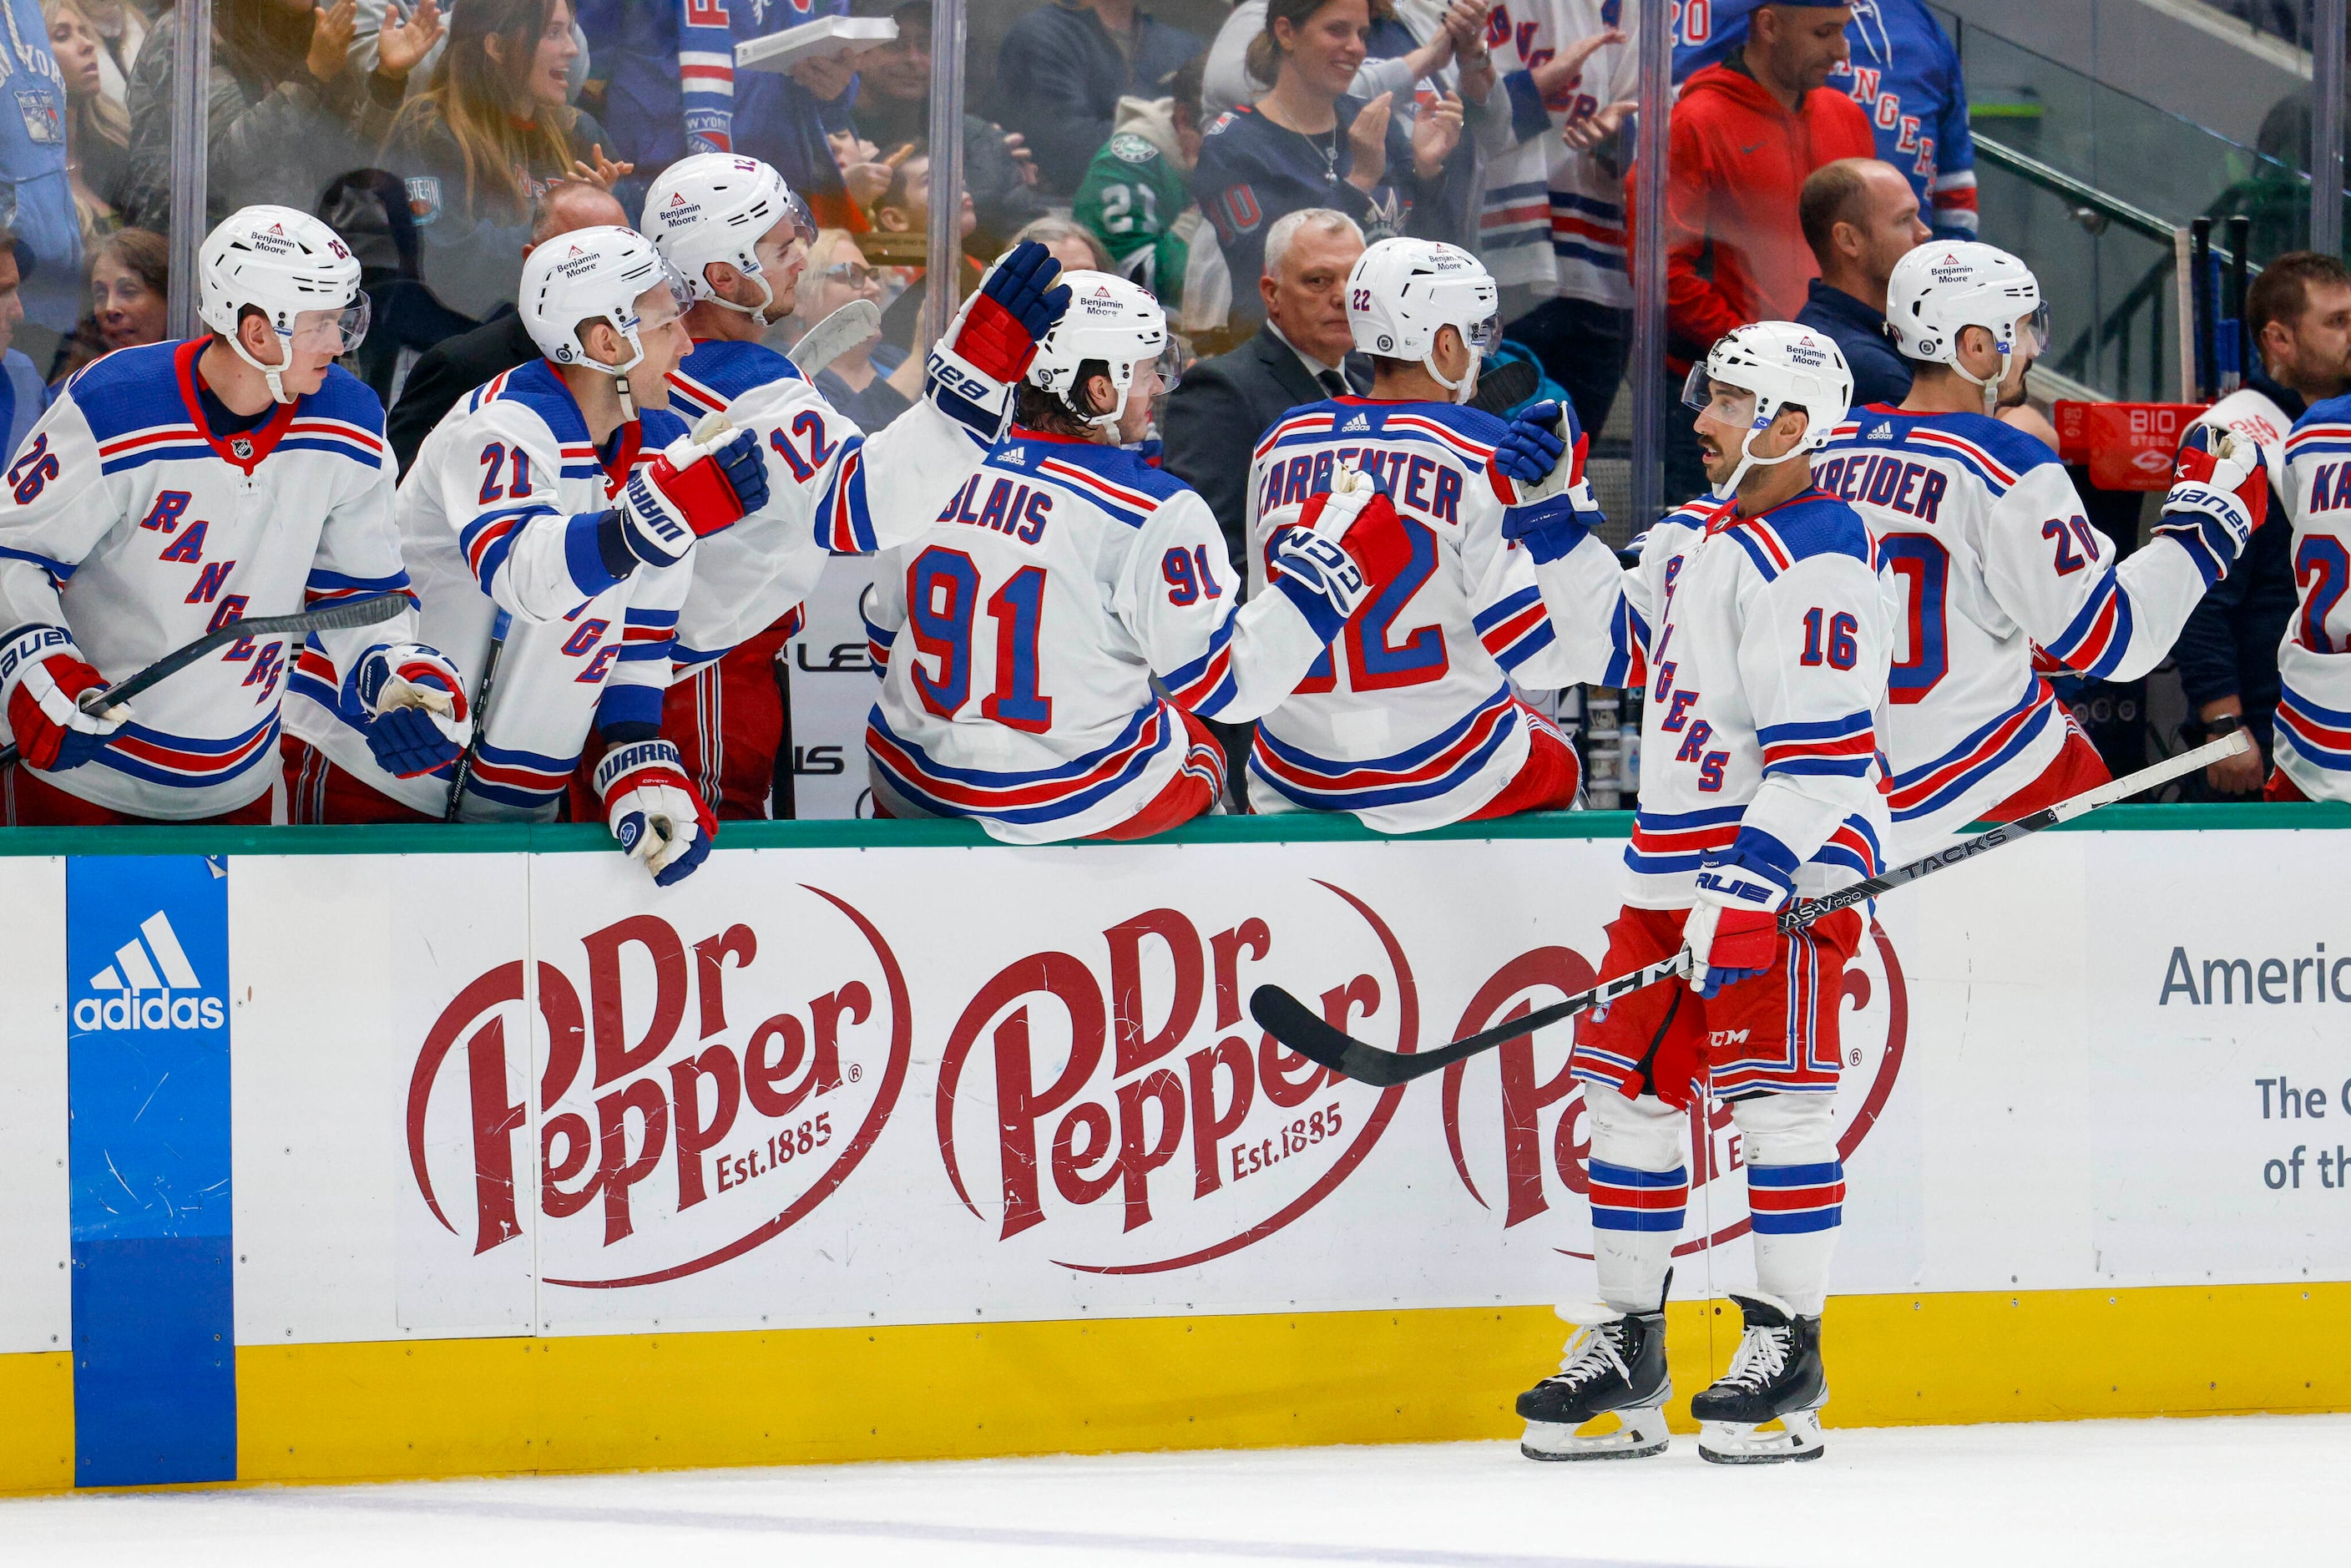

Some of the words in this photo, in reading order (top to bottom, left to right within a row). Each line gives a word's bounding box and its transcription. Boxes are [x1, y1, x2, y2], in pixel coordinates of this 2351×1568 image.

[734, 159, 756, 172] 12
[660, 203, 701, 220] Benjamin
[1101, 184, 1158, 233] 21
[669, 215, 697, 228] Moore
[250, 231, 296, 249] Benjamin
[255, 241, 286, 255] Moore
[557, 252, 600, 273] Benjamin
[566, 262, 597, 279] Moore
[1931, 266, 1974, 276] Benjamin
[1939, 275, 1968, 284] Moore
[1080, 297, 1124, 310] Benjamin
[1087, 306, 1117, 316] Moore
[1353, 289, 1371, 311] 22
[1787, 345, 1827, 360] Benjamin
[1792, 355, 1821, 367] Moore
[1342, 423, 1370, 432] adidas
[2130, 409, 2176, 433] BIO
[770, 410, 838, 484] 12
[2130, 435, 2175, 447] STEEL
[8, 432, 59, 504] 26
[997, 454, 1026, 466] adidas
[479, 442, 532, 505] 21
[2041, 514, 2099, 577] 20
[1161, 544, 1223, 606] 91
[907, 544, 1053, 735] 91
[1800, 607, 1858, 671] 16
[1898, 827, 2009, 879] TACKS
[1696, 873, 1773, 903] RUE
[580, 914, 757, 1090] Dr
[1102, 908, 1271, 1080] Dr
[73, 989, 225, 1031] adidas
[407, 959, 872, 1257] Pepper
[2255, 1076, 2327, 1119] The
[2264, 1145, 2306, 1190] of
